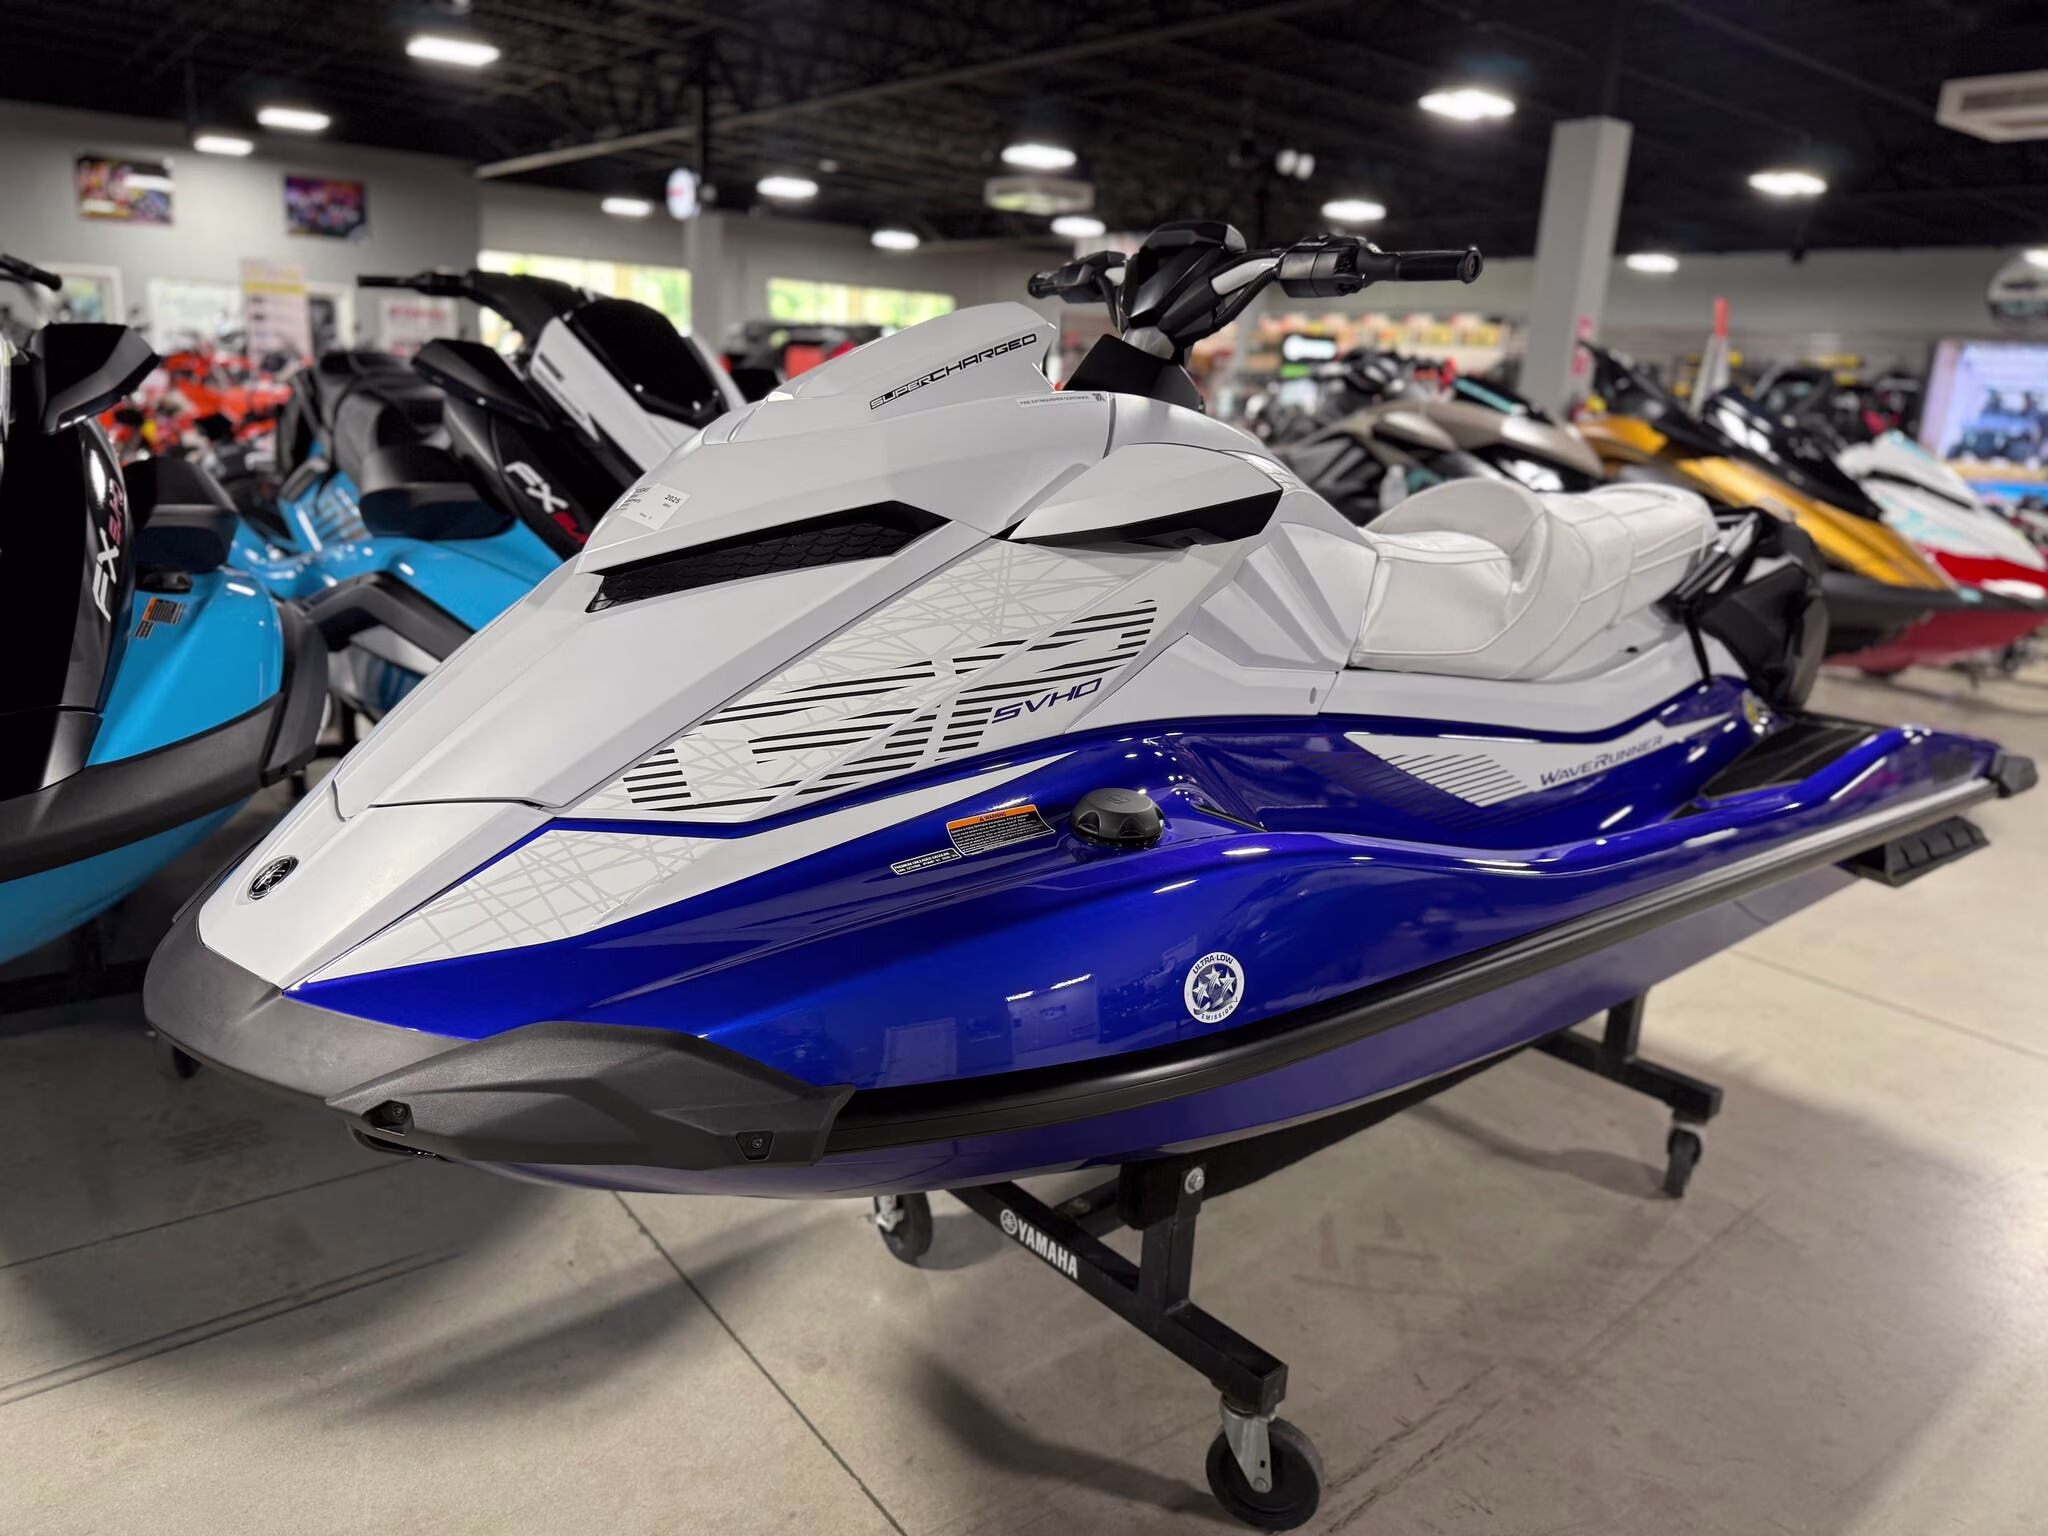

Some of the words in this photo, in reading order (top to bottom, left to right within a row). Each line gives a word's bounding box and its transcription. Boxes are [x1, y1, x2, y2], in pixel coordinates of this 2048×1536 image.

[870, 333, 1037, 410] SUPERCHARGED
[505, 461, 569, 513] FX
[665, 494, 681, 504] 2025
[92, 527, 120, 623] FX
[991, 677, 1102, 724] SVHO
[985, 811, 1007, 820] WARNING
[1201, 1004, 1233, 1020] EMISSION
[1018, 1218, 1078, 1279] YAMAHA
